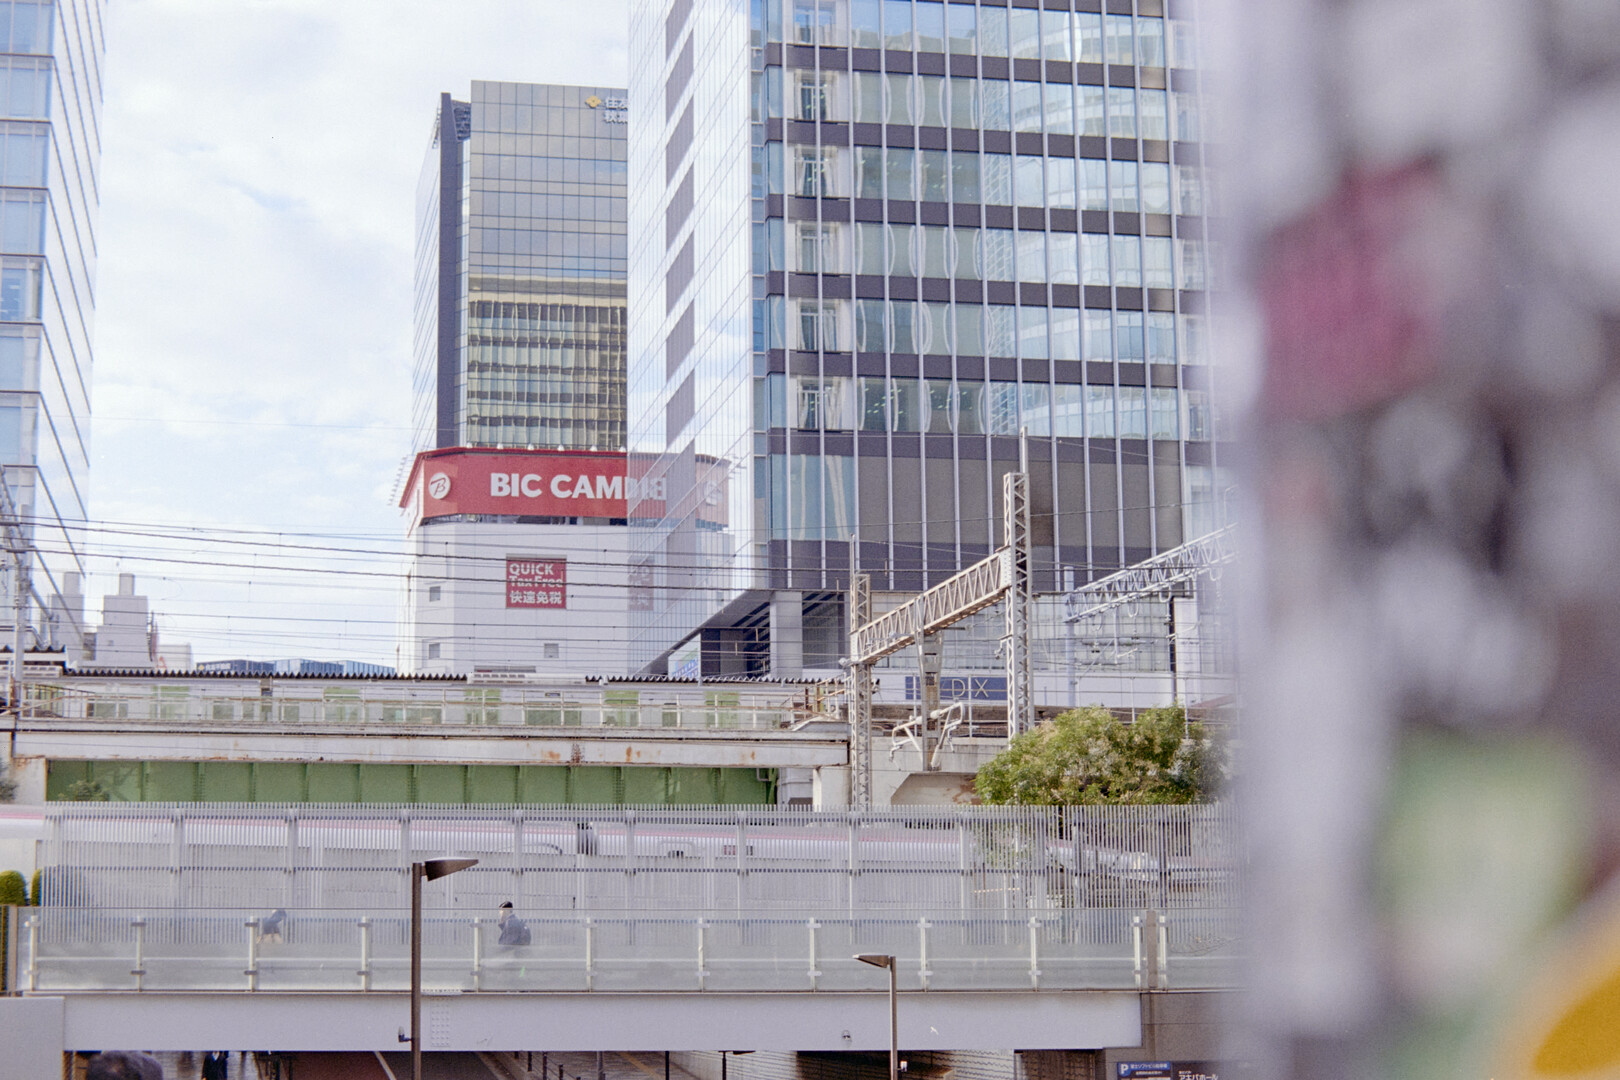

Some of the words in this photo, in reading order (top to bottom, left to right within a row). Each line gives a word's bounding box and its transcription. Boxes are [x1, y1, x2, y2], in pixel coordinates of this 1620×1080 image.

[490, 473, 541, 497] BIC
[550, 475, 628, 500] CAM
[509, 563, 554, 576] QUICK
[509, 575, 533, 587] Tax
[534, 575, 564, 588] Free
[1120, 1063, 1129, 1075] P
